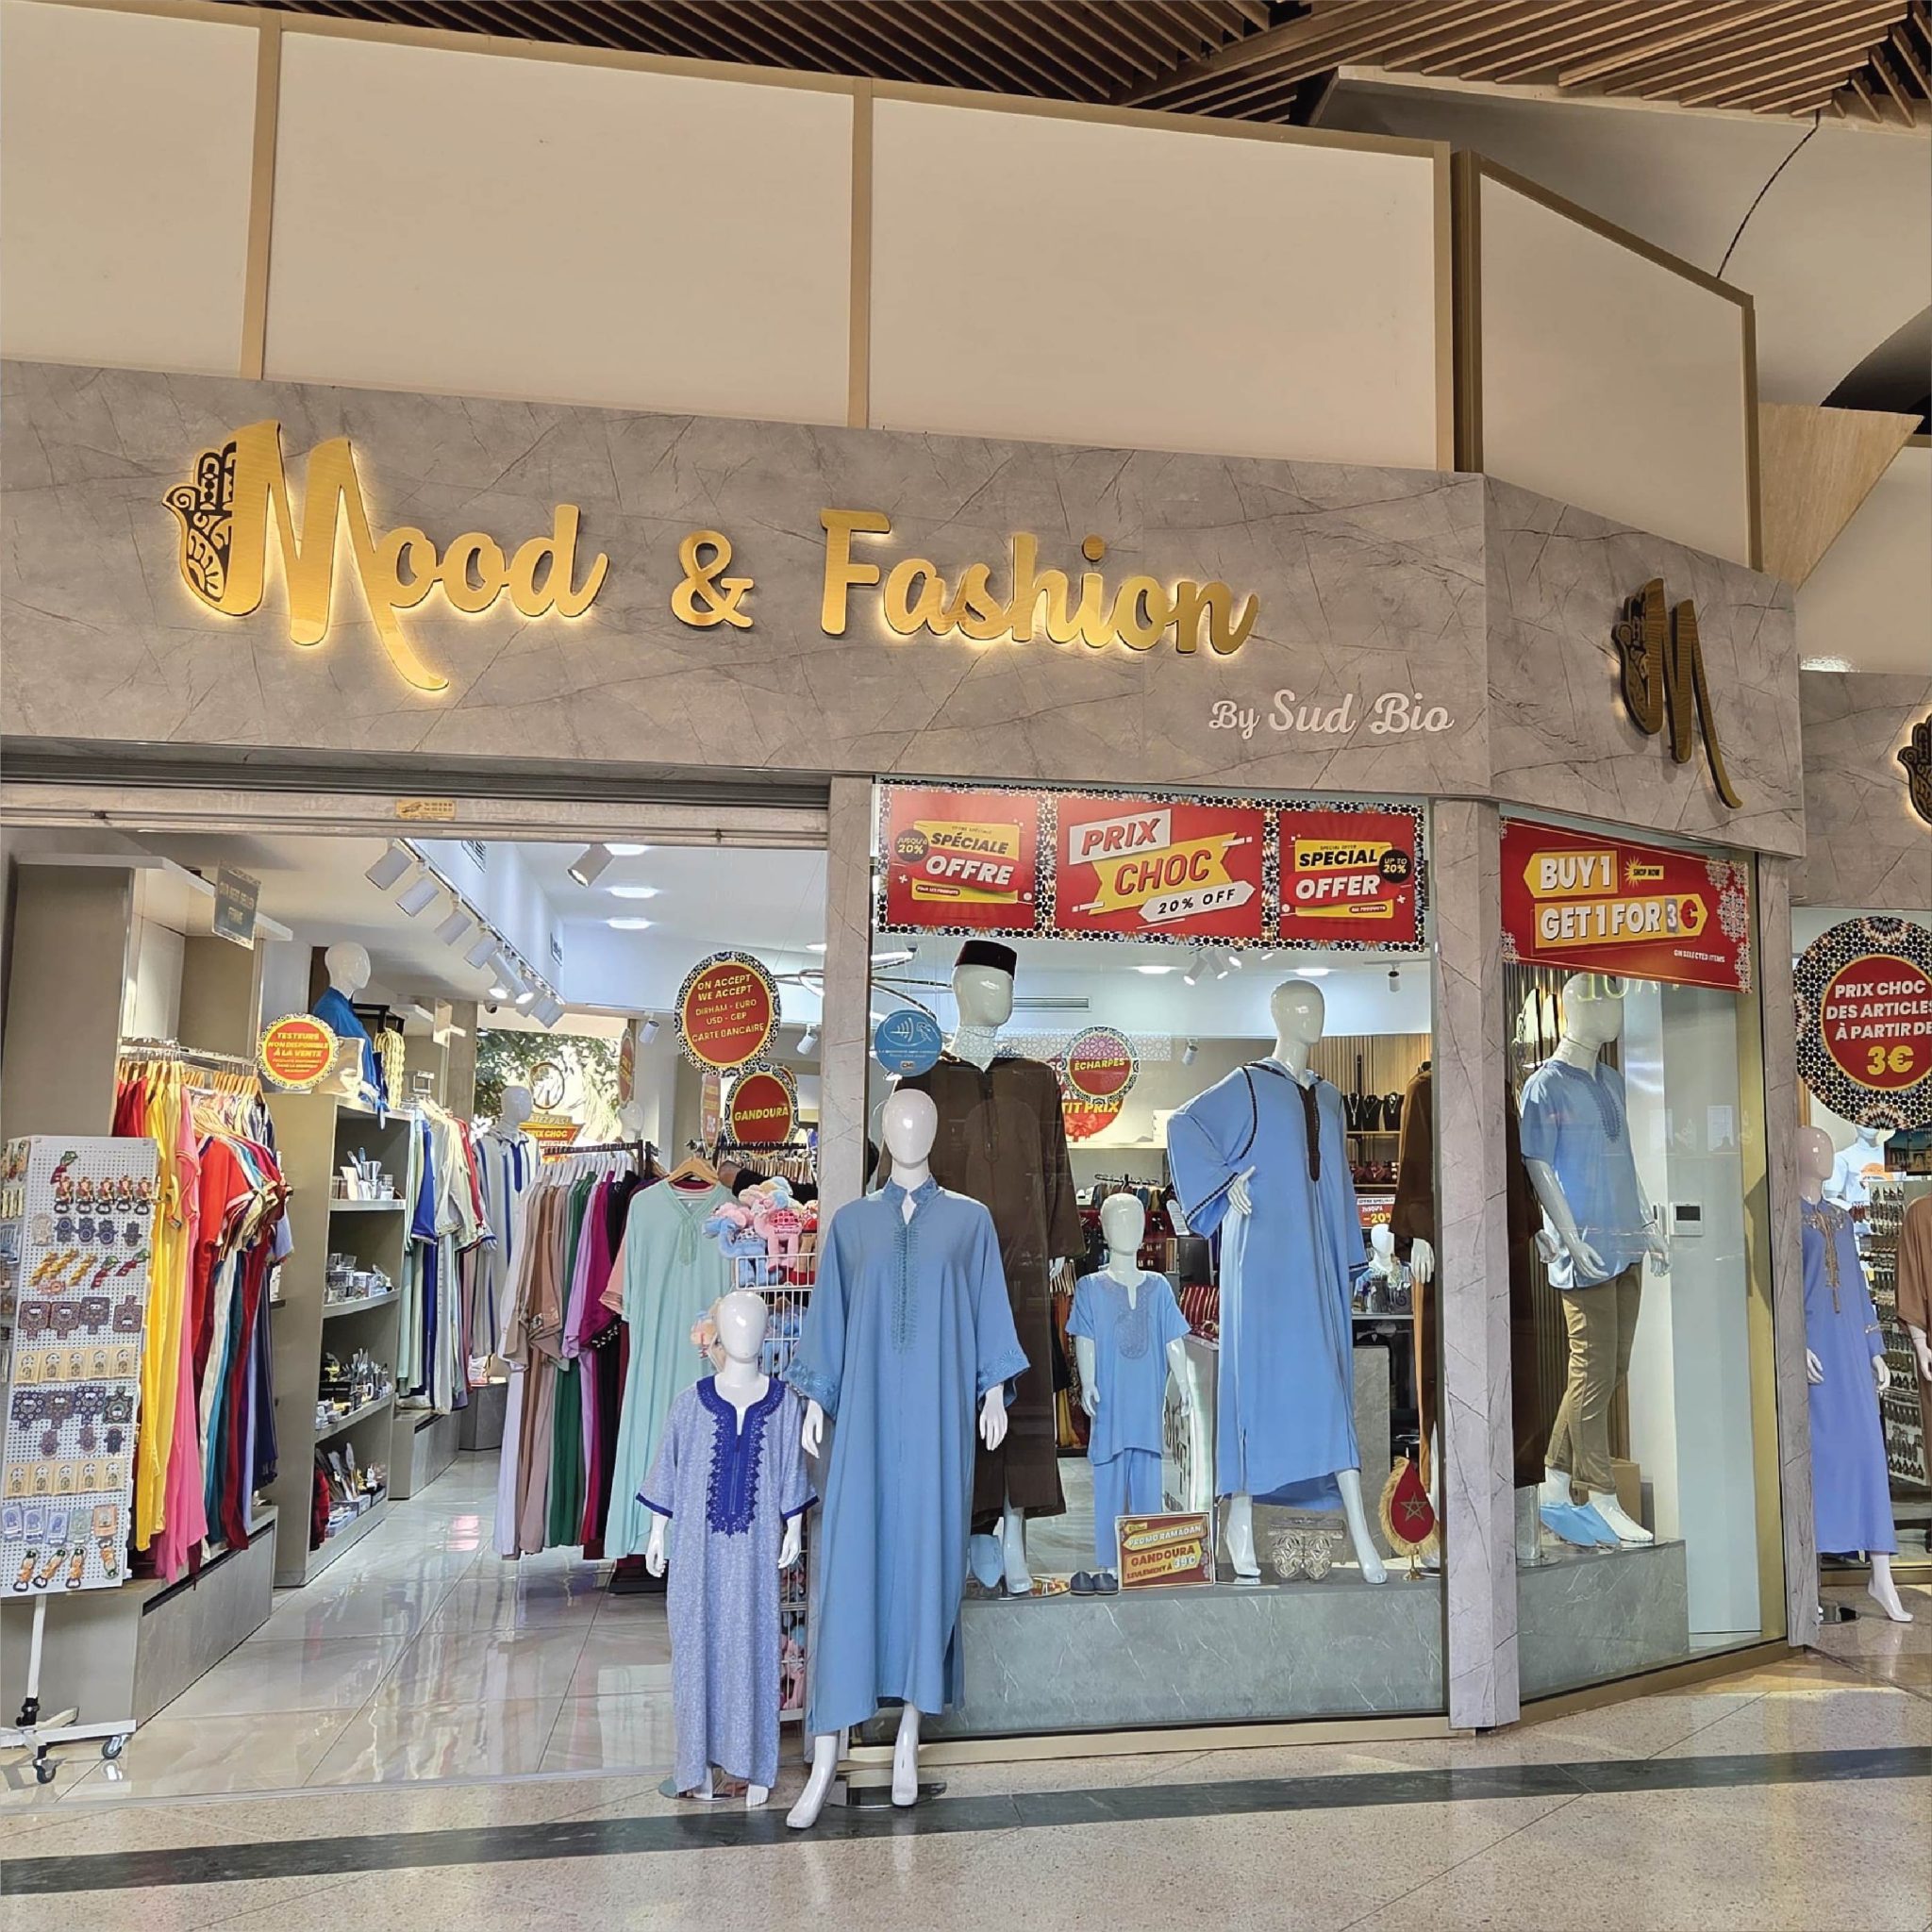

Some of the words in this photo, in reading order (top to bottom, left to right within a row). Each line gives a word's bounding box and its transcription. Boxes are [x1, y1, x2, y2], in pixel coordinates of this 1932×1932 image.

[162, 420, 609, 691] Mood
[671, 530, 753, 629] &
[819, 507, 1258, 655] Fashion
[1208, 700, 1260, 740] By
[1269, 689, 1357, 733] Sud
[1369, 692, 1455, 734] Bio
[931, 833, 1008, 854] SPÉCIALE
[1081, 818, 1160, 856] PRIX
[898, 845, 923, 855] 20%
[1299, 849, 1377, 867] SPECIAL
[926, 856, 1014, 885] OFFRE
[1115, 849, 1211, 895] CHOC
[1383, 864, 1406, 874] 20%
[1541, 856, 1596, 890] BUY
[1296, 874, 1380, 899] OFFER
[1158, 897, 1193, 915] 20%
[1203, 889, 1235, 905] OFF
[1541, 906, 1591, 941] GET
[1611, 902, 1661, 934] FOR
[698, 981, 711, 990] ON
[714, 974, 751, 988] ACCEPT
[1835, 983, 1874, 998] PRIX
[1877, 980, 1926, 995] CHOC
[698, 992, 712, 1001] WE
[715, 985, 753, 998] ACCEPT
[696, 1004, 727, 1015] DIRHAM
[736, 999, 757, 1009] EURO
[1826, 1006, 1857, 1020] DES
[706, 1016, 723, 1024] USD
[692, 1030, 720, 1041] CARTE
[721, 1023, 764, 1037] BANCAIRE
[1836, 1023, 1848, 1041] À
[1851, 1023, 1911, 1039] PARTIR
[1074, 1058, 1124, 1071] ÉCHARPES
[1867, 1045, 1914, 1075] 3€
[734, 1107, 789, 1122] GANDOURA
[1062, 1102, 1082, 1113] TIT
[1085, 1101, 1119, 1113] PRIX
[1129, 1534, 1158, 1546] PROMO
[1159, 1524, 1201, 1540] RAMADAN
